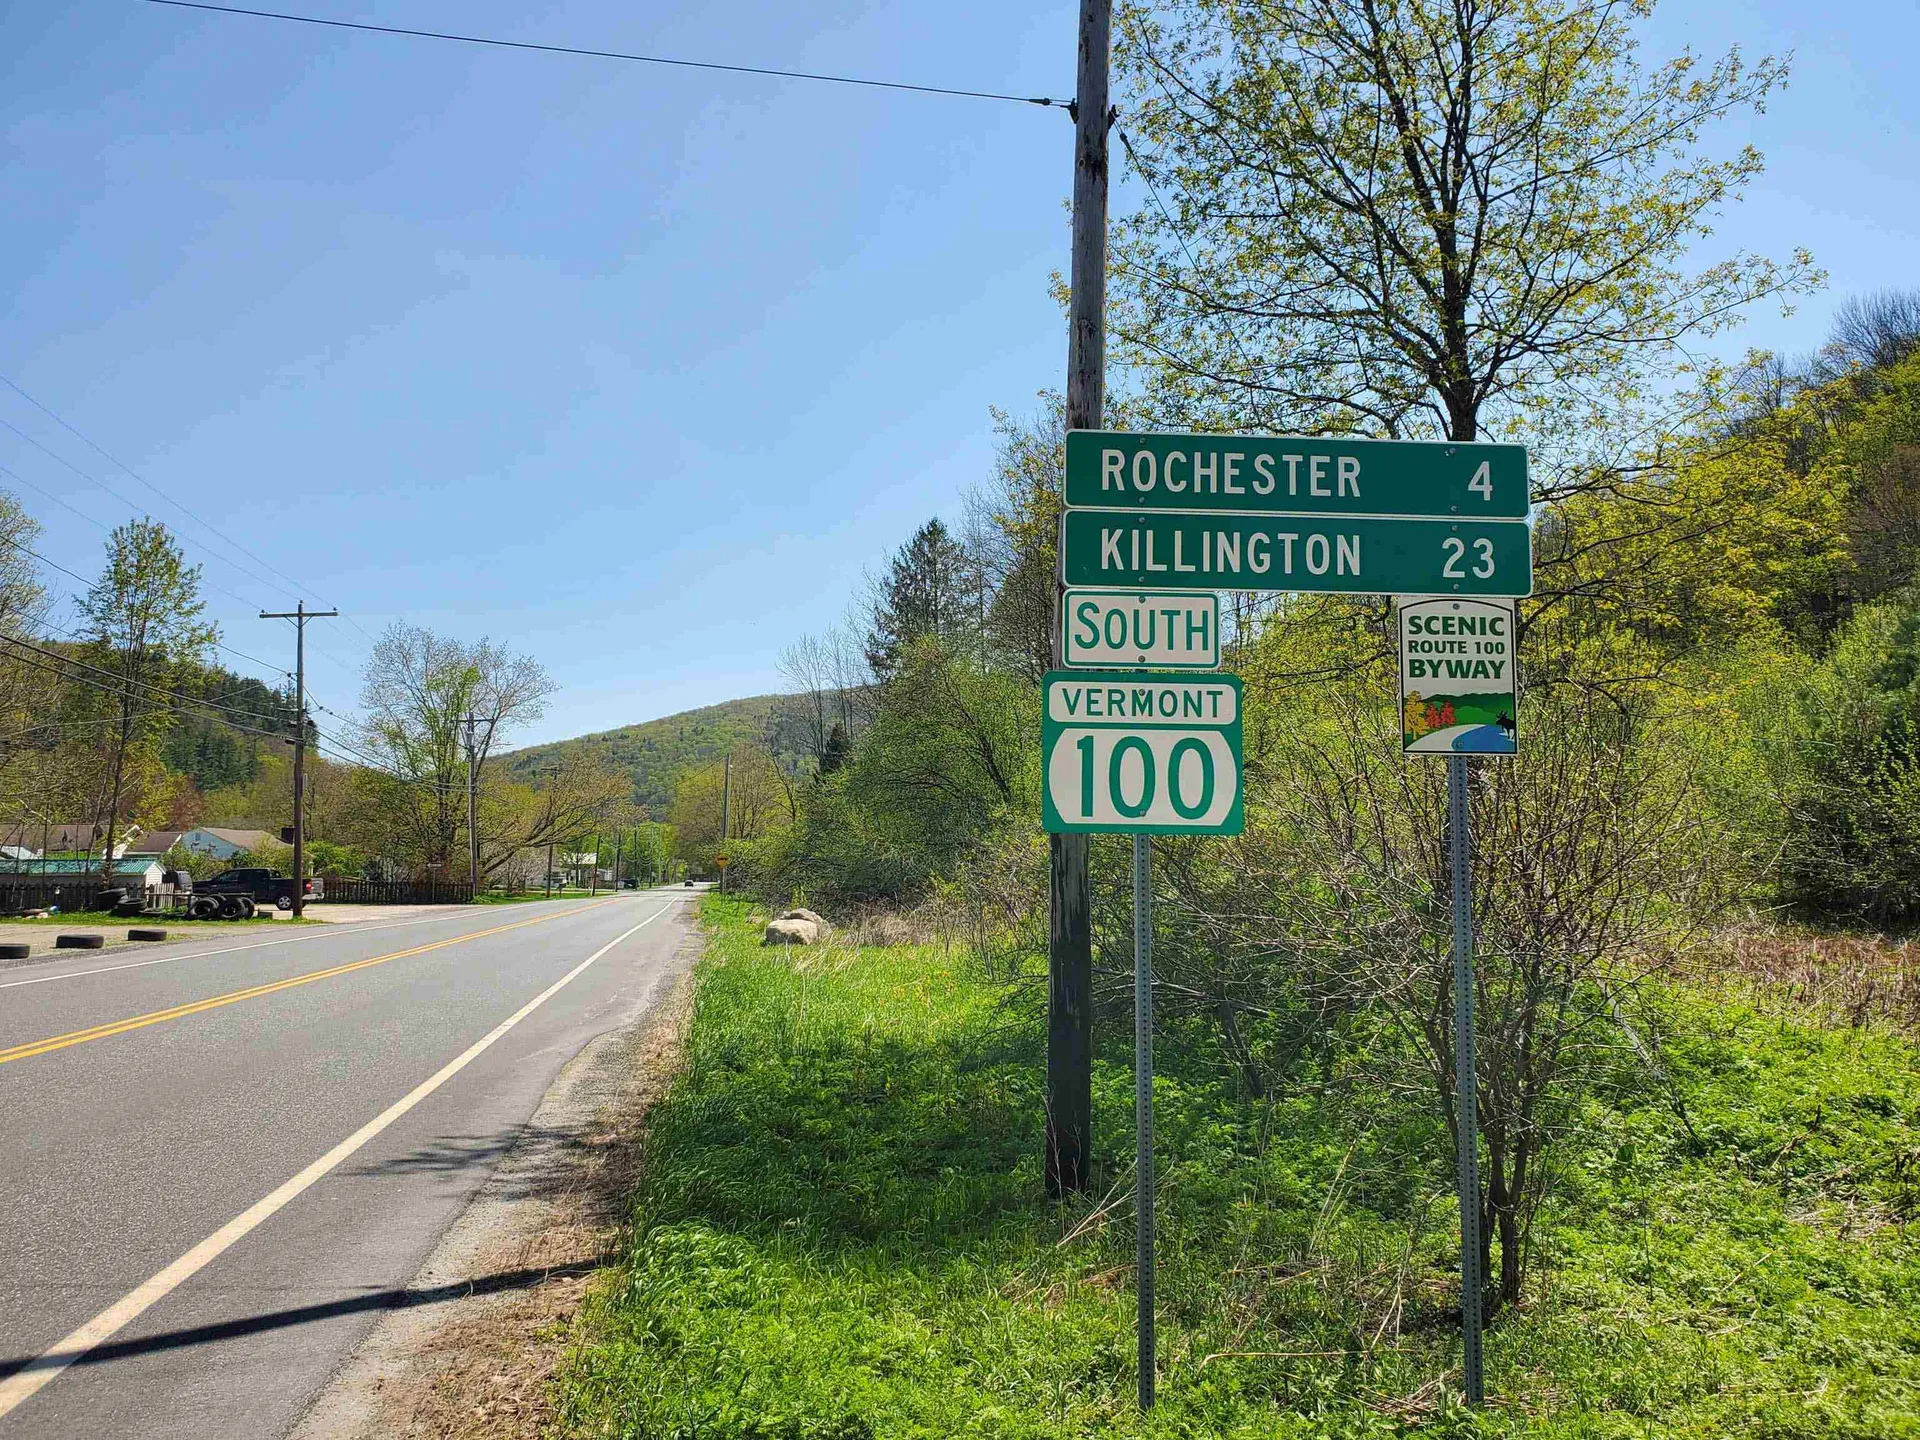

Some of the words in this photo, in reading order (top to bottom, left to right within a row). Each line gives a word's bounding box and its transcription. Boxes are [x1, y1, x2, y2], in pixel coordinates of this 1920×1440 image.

[1101, 449, 1361, 498] ROCHESTER
[1467, 460, 1493, 501] 4
[1101, 528, 1361, 576] KILLINGTON
[1441, 537, 1495, 579] 23
[1074, 602, 1209, 652] SOUTH
[1408, 615, 1505, 636] SCENIC
[1408, 640, 1467, 654] ROUTE
[1475, 641, 1505, 655] 100
[1409, 659, 1506, 679] BYWAY
[1061, 688, 1223, 718] VERMONT
[1076, 735, 1215, 820] 100
